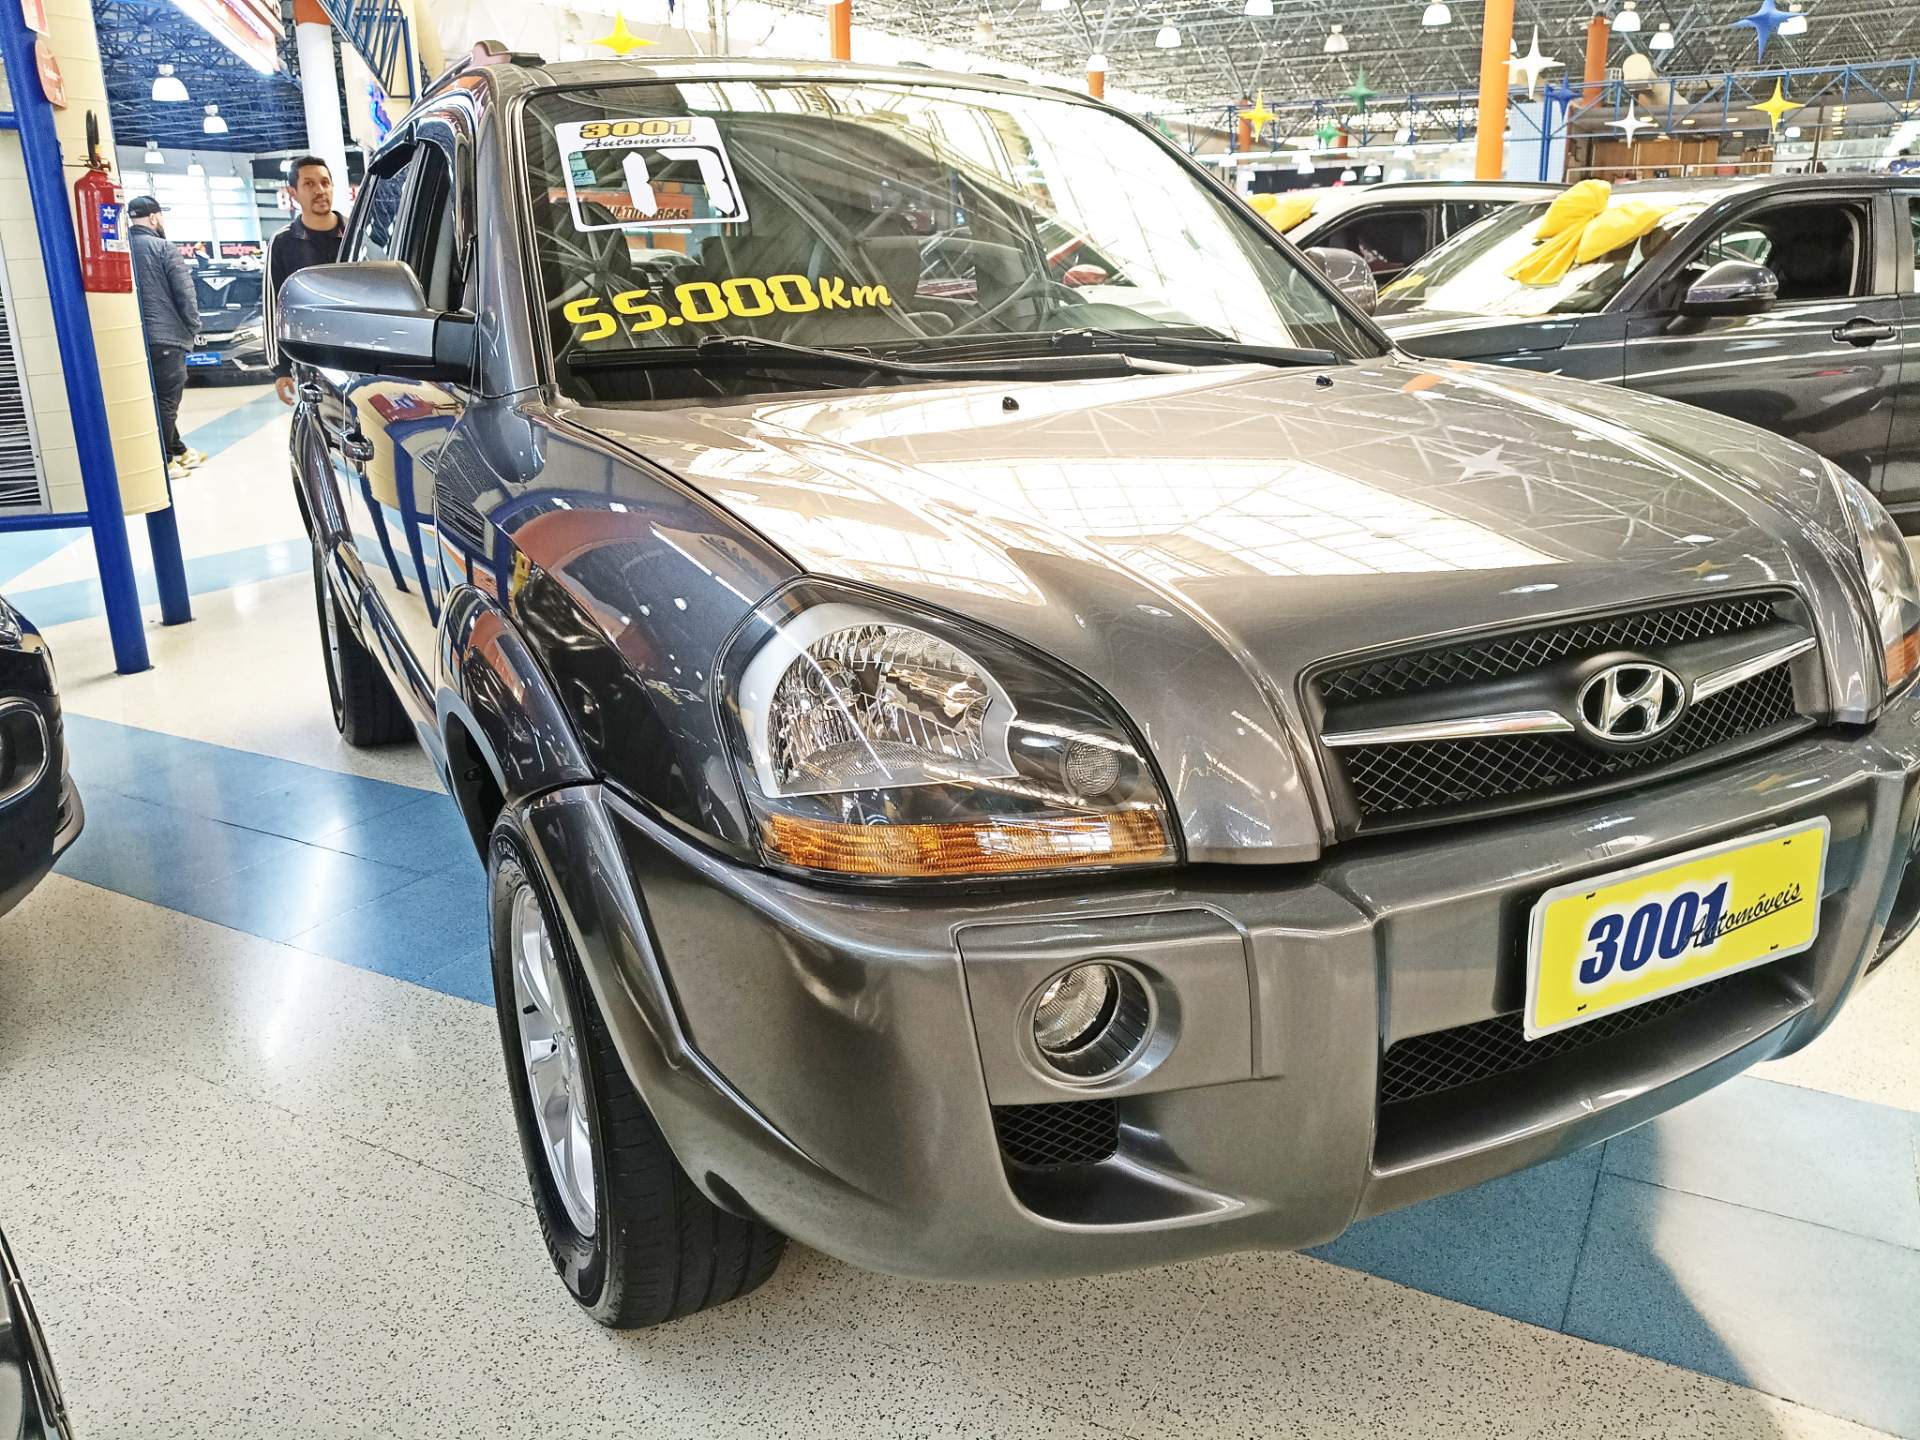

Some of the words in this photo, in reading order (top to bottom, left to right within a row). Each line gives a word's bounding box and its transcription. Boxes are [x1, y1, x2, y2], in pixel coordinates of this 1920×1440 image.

[580, 119, 692, 139] 3001
[583, 136, 697, 149] Automóveis
[1579, 881, 1728, 985] 3001
[1679, 882, 1803, 953] Automóveis
